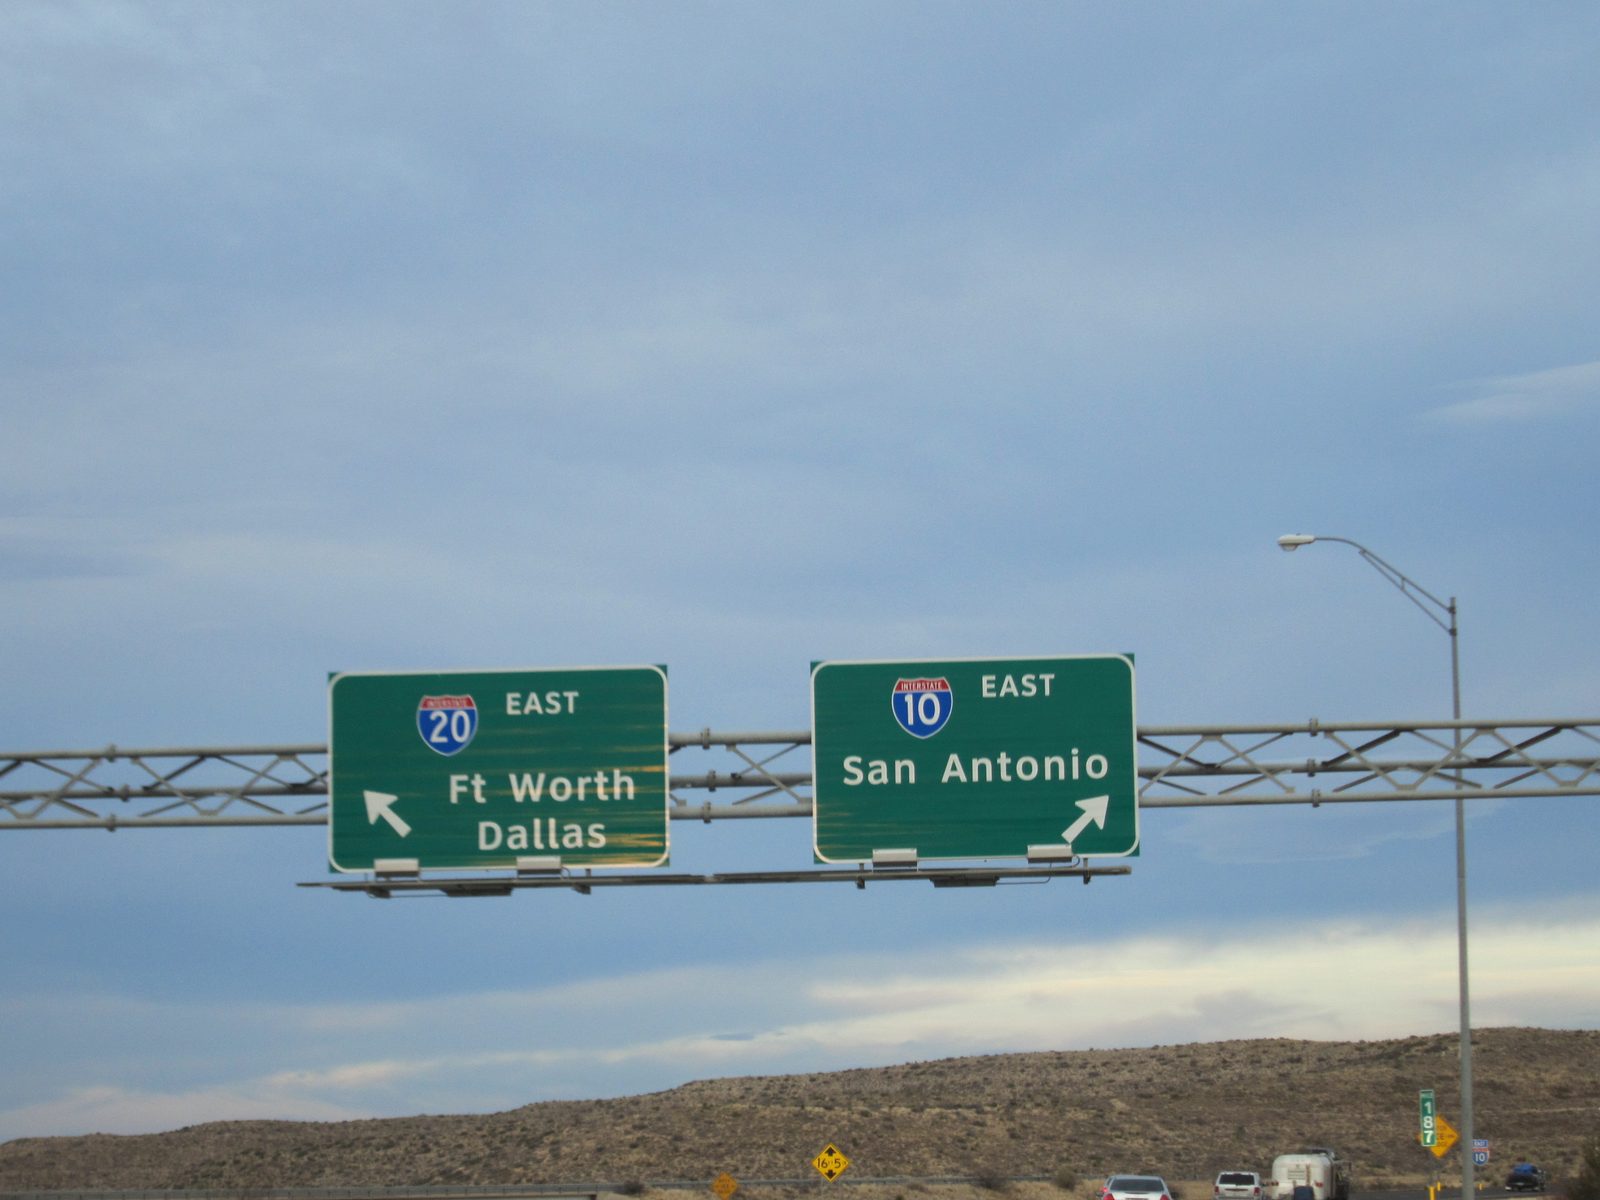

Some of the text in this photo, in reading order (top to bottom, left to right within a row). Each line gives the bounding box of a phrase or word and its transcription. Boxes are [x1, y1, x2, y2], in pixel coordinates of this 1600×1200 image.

[901, 681, 943, 691] INTERSTATE
[982, 673, 1055, 698] EAST
[506, 691, 579, 715] EAST
[904, 693, 941, 726] 10
[429, 710, 471, 743] 20
[843, 748, 1109, 787] San Antonio
[449, 768, 635, 804] Ft Worth
[478, 817, 607, 850] Dallas
[1475, 1153, 1486, 1162] 10
